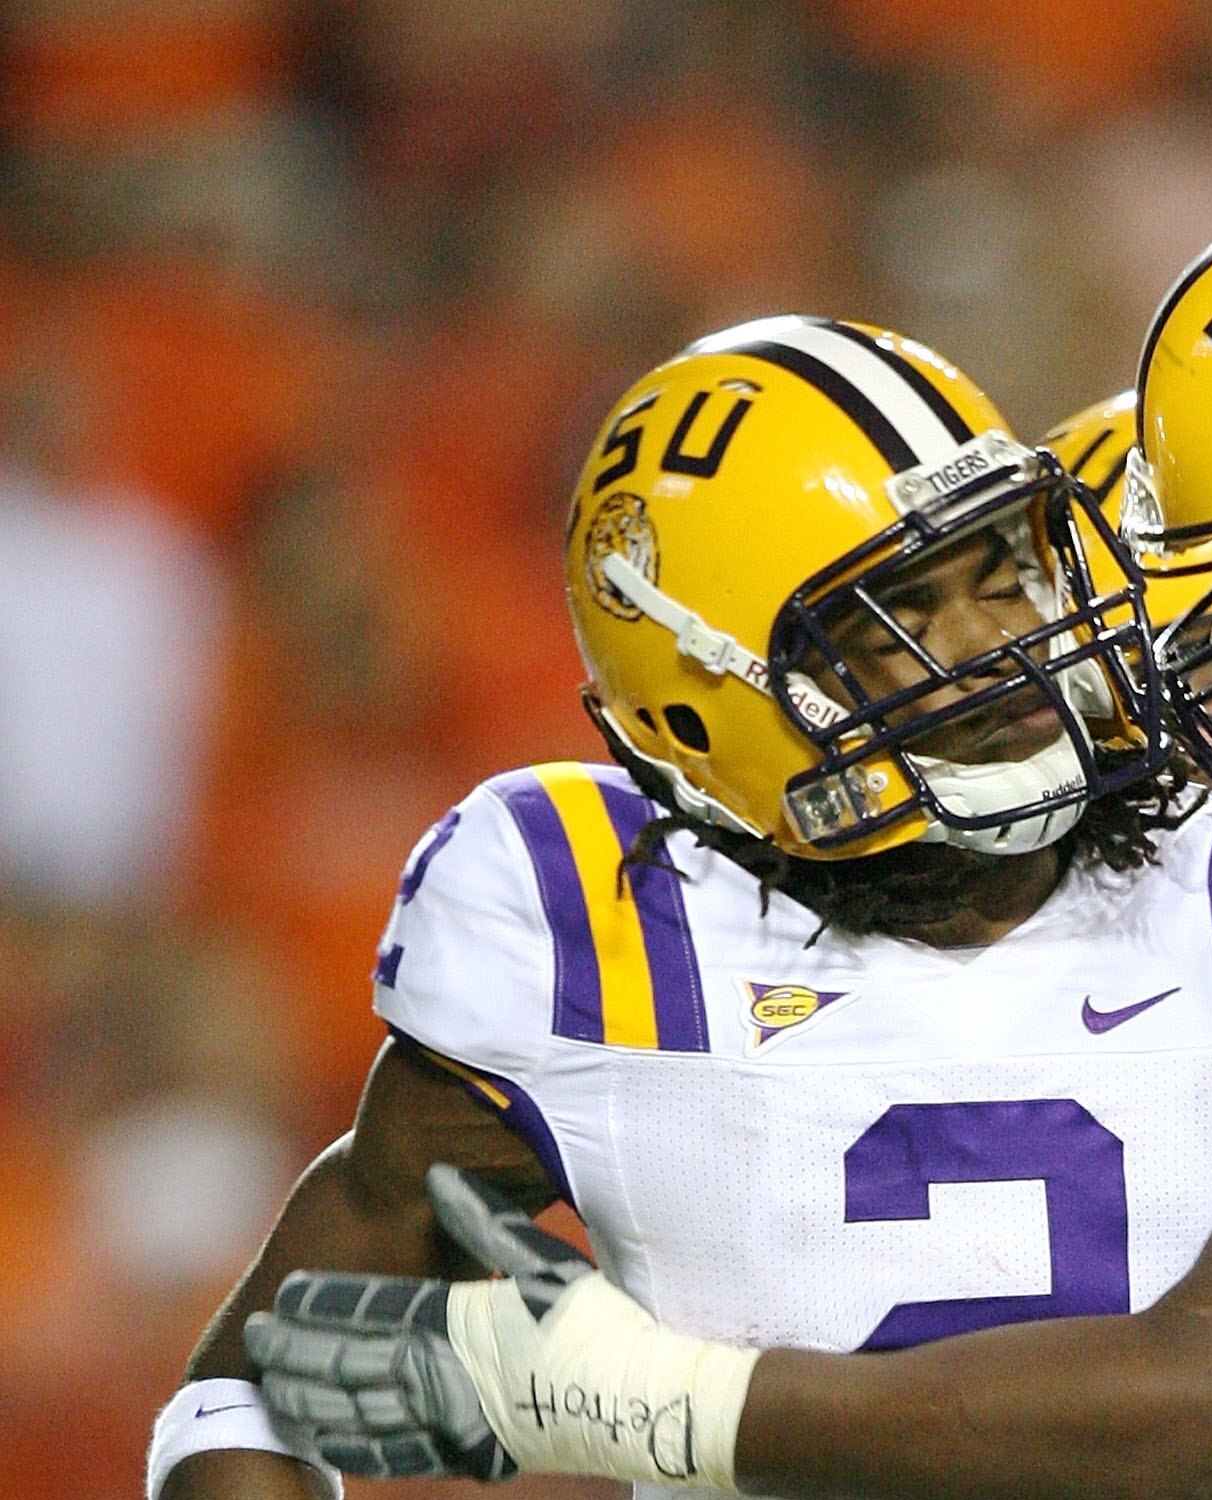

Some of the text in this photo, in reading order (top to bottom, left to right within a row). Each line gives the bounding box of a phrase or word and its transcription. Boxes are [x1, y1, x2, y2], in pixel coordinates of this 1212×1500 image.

[926, 450, 989, 493] TIGERS
[761, 1004, 807, 1017] SEC
[516, 1371, 698, 1479] Detroit
